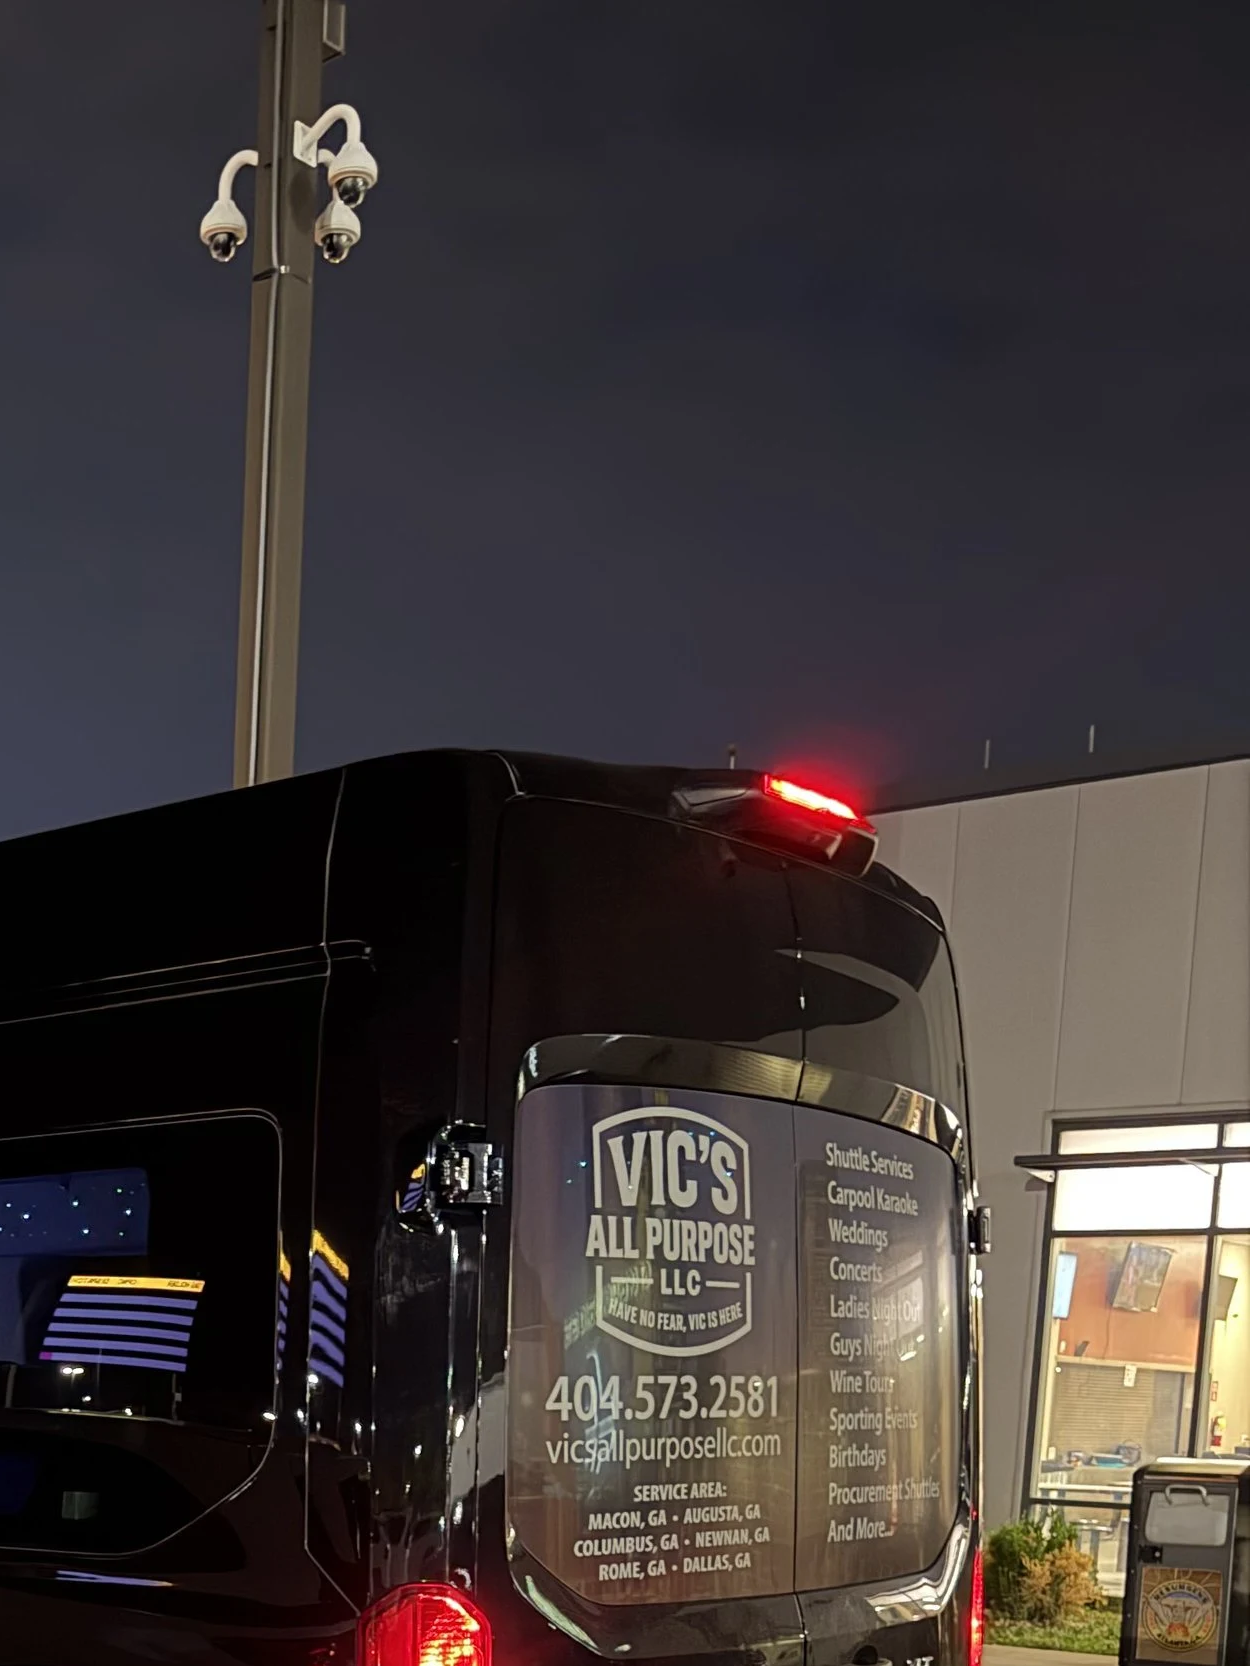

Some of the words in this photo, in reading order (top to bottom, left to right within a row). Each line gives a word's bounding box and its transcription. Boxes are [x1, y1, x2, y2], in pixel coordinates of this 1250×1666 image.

[607, 1129, 738, 1215] VIC'S
[826, 1142, 870, 1172] Shuttle
[871, 1150, 914, 1180] Services
[827, 1180, 876, 1212] Carpool
[876, 1187, 919, 1217] Karaoke
[585, 1214, 640, 1259] ALL
[645, 1216, 756, 1266] PURPOSE
[828, 1218, 889, 1252] Weddings
[660, 1268, 701, 1296] LLC
[830, 1256, 883, 1283] Concerts
[607, 1298, 637, 1324] HAVE
[639, 1308, 655, 1327] NO
[657, 1312, 686, 1333] FEAR,
[688, 1312, 706, 1331] VIC
[707, 1308, 719, 1327] IS
[719, 1302, 743, 1325] HERE
[830, 1294, 870, 1320] Ladies
[830, 1332, 862, 1363] Guys
[830, 1369, 862, 1394] Wine
[863, 1370, 895, 1394] Tours
[545, 1374, 779, 1422] 404.573.2581
[829, 1407, 883, 1436] Sporting
[885, 1405, 918, 1430] Events
[545, 1426, 781, 1470] vicsallpurposellc.com
[829, 1442, 886, 1472] Birthdays
[633, 1483, 688, 1502] SERVICE
[690, 1482, 727, 1499] AREA:
[828, 1481, 903, 1506] Procurement
[904, 1476, 940, 1499] Shuttles
[588, 1511, 645, 1530] MACON,
[648, 1509, 666, 1527] GA
[683, 1506, 743, 1524] AUGUSTA,
[745, 1504, 761, 1520] GA
[827, 1516, 854, 1543] And
[573, 1535, 658, 1557] COLUMBUS,
[660, 1534, 679, 1550] GA
[695, 1528, 752, 1548] NEWNAN,
[754, 1527, 770, 1543] GA
[599, 1561, 645, 1581] ROME,
[647, 1560, 666, 1577] GA
[683, 1555, 733, 1573] DALLAS,
[735, 1553, 751, 1568] GA
